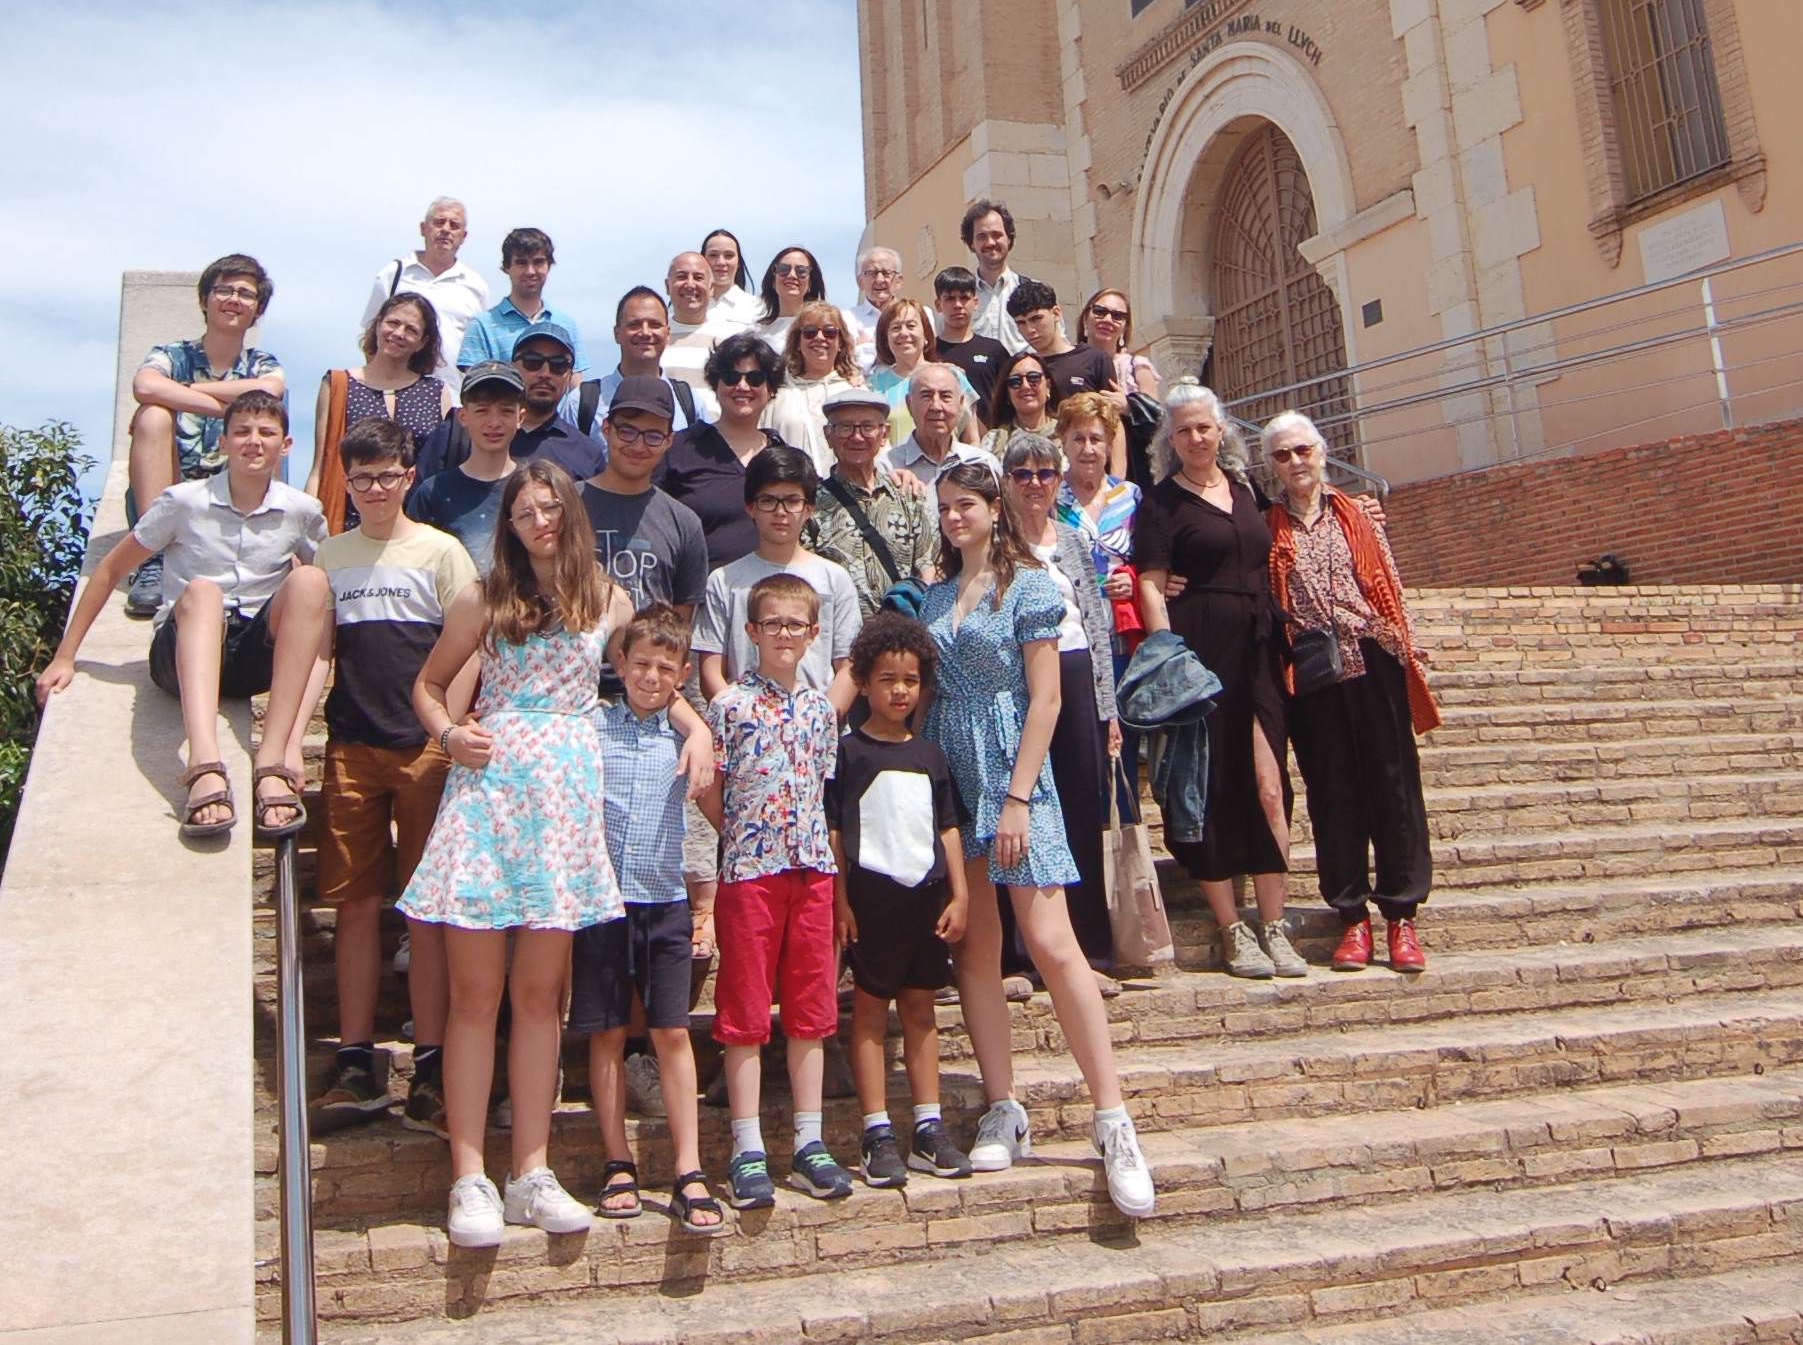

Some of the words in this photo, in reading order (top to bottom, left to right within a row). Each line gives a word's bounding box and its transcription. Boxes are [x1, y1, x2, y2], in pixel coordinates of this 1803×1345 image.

[1190, 30, 1223, 68] SANTA
[1227, 14, 1261, 38] MARIA
[1265, 20, 1282, 36] DEL
